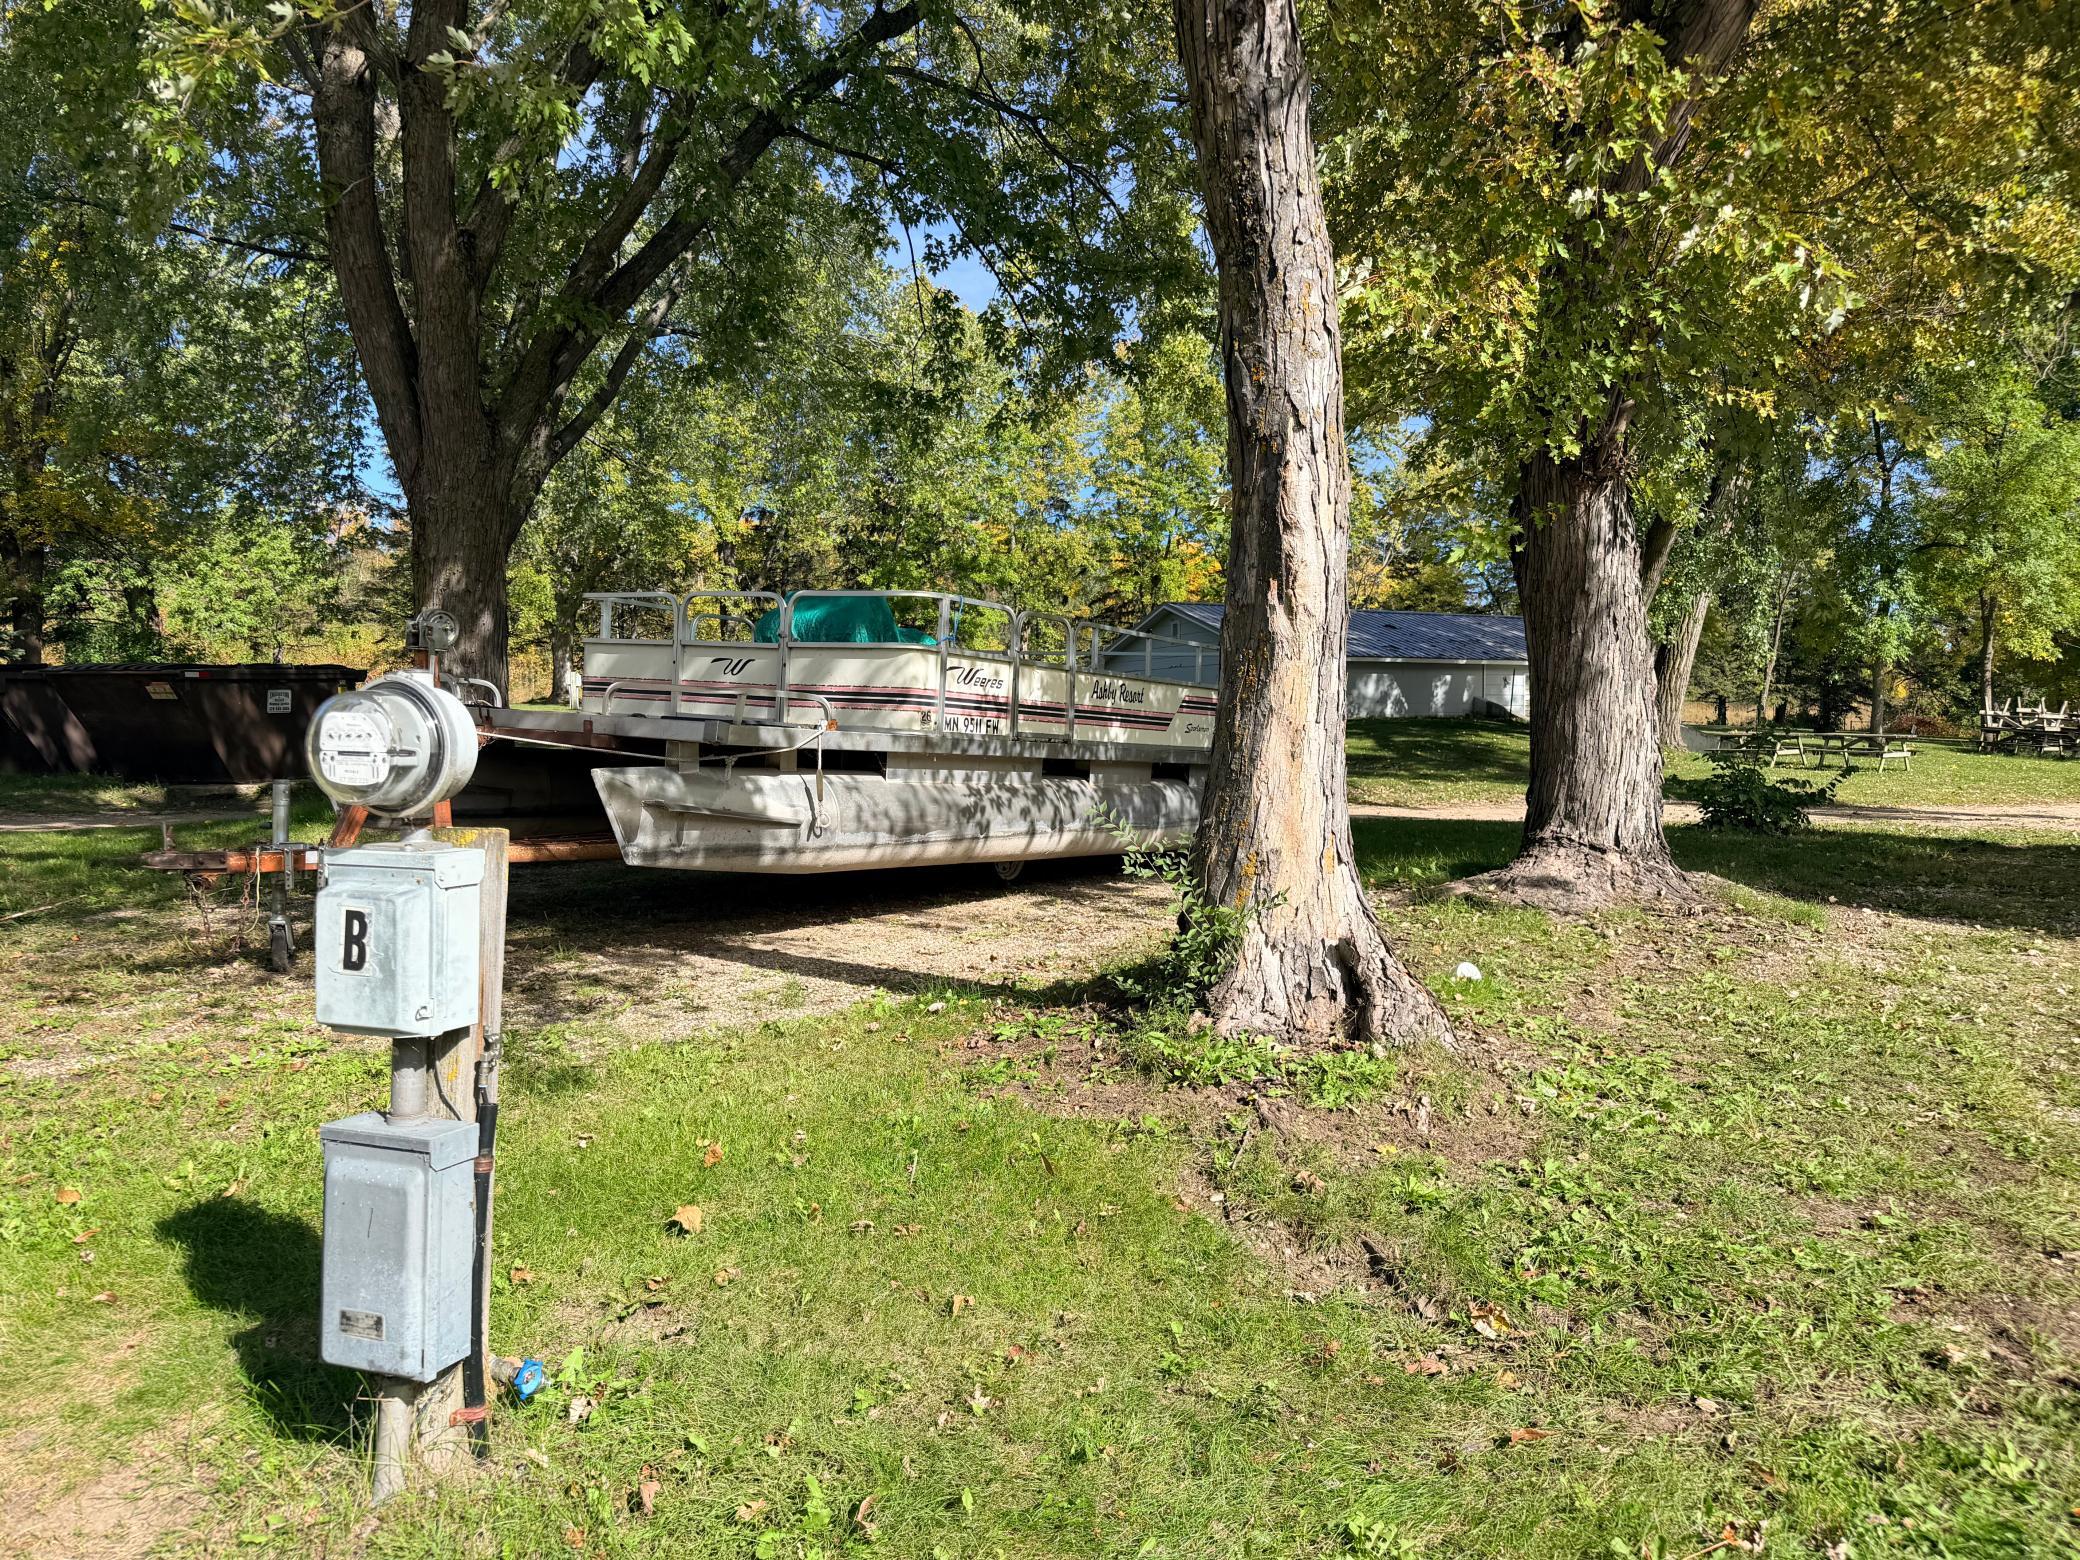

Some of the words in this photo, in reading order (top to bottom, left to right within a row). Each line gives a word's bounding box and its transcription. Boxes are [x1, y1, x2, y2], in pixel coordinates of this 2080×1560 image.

[711, 657, 755, 675] W
[947, 666, 1003, 689] Weeres
[1091, 680, 1117, 705] Ashby
[1120, 683, 1144, 703] Resort
[921, 711, 932, 722] 26
[944, 717, 959, 732] MN
[963, 718, 982, 733] 9511
[985, 719, 1000, 734] FW
[342, 909, 368, 972] B
